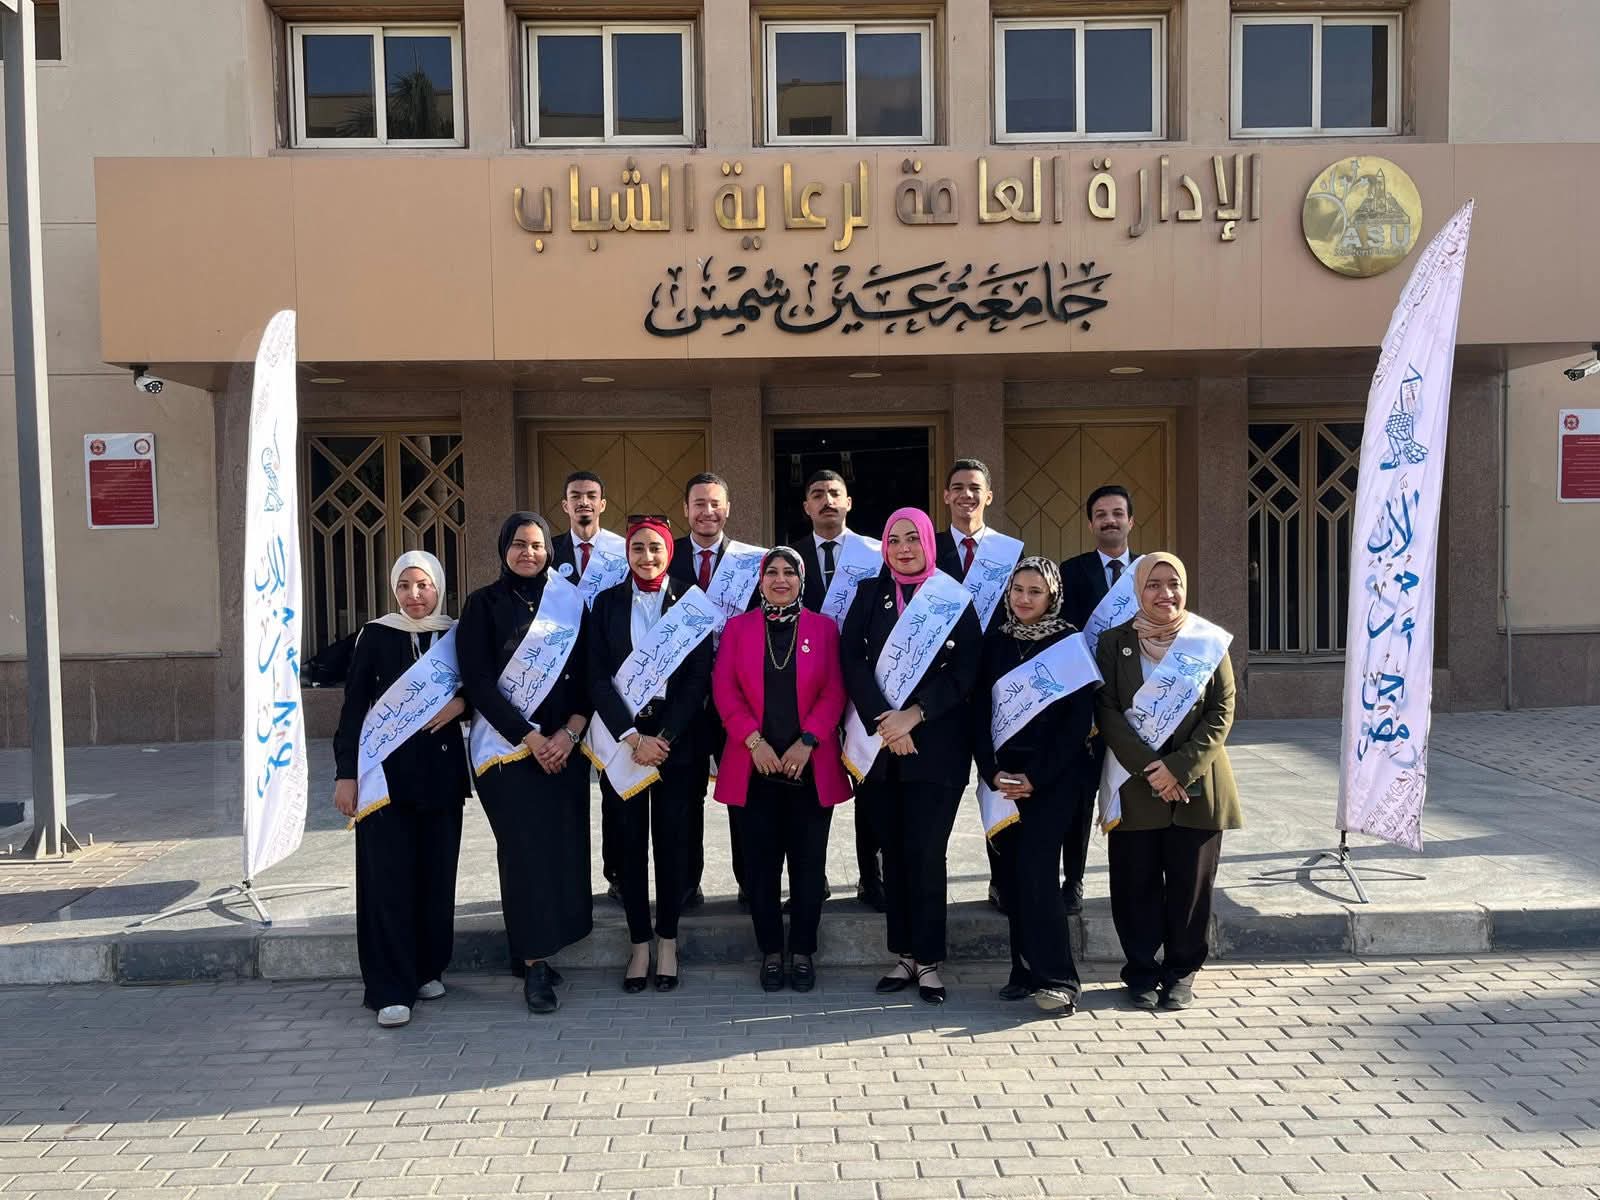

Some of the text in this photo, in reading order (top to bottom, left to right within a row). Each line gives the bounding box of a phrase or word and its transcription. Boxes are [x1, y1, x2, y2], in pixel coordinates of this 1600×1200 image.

[513, 154, 1261, 253] الإدارة العامة لرعاية الشباب
[1342, 224, 1410, 248] ASU
[644, 256, 1112, 337] جامعة عين شمس
[719, 570, 734, 591] طلاب
[833, 589, 848, 614] طلاب
[1112, 595, 1130, 616] طلاب
[659, 622, 678, 644] طلاب
[908, 613, 927, 636] طلاب
[522, 647, 541, 670] طلاب
[404, 679, 426, 702] طلاب
[1002, 681, 1024, 703] طلاب
[1156, 675, 1176, 700] طلاب
